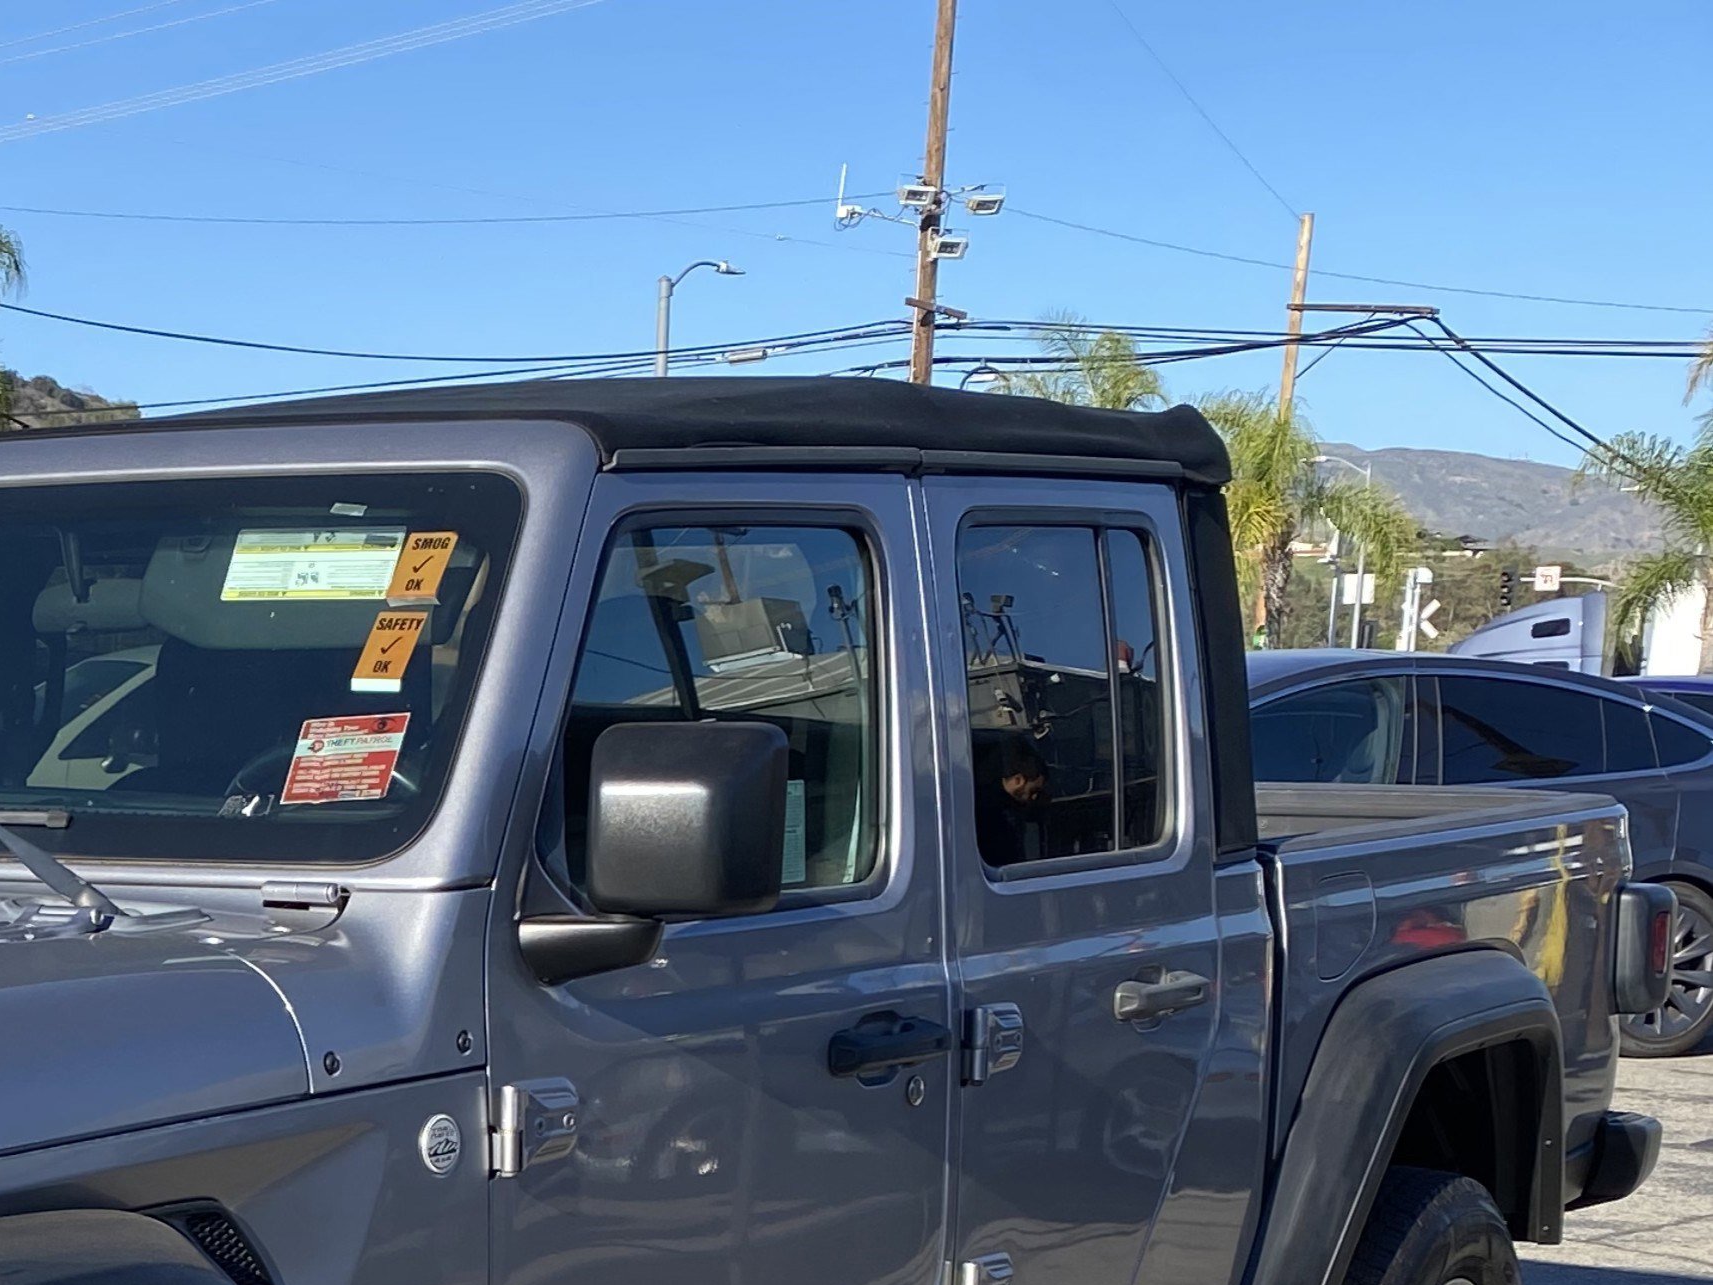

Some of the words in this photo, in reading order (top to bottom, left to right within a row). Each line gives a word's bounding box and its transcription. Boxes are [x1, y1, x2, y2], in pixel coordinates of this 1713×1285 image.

[412, 537, 451, 550] SMOG
[405, 578, 424, 592] OK
[376, 617, 425, 631] SAFETY
[373, 660, 392, 673] OK
